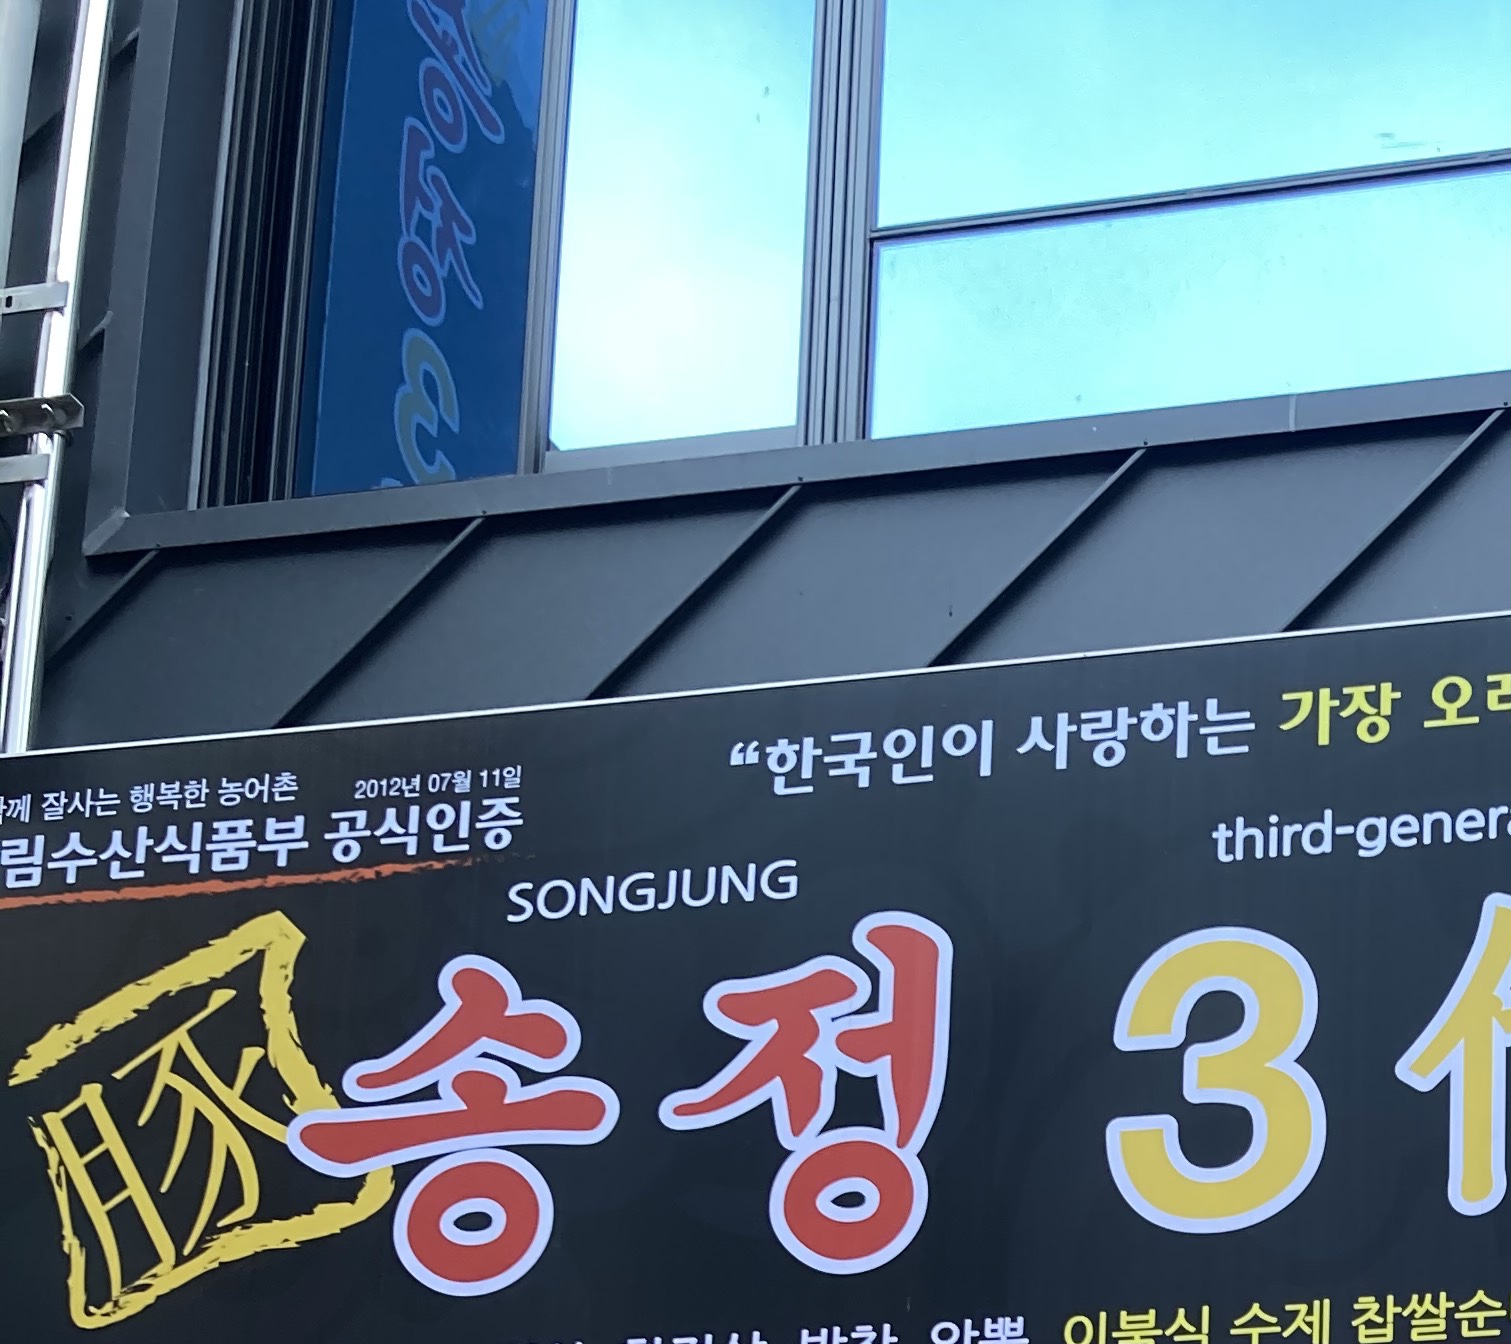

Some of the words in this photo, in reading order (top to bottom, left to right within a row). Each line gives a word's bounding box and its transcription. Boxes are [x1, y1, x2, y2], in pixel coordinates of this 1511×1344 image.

[730, 719, 994, 797] “한국인이
[1016, 697, 1257, 771] 사랑하는
[1280, 680, 1402, 747] 가장
[41, 786, 122, 822] 잘사는
[130, 777, 210, 814] 행복한
[217, 771, 299, 808] 농어촌
[354, 772, 421, 801] 2012년
[428, 768, 472, 796] 07월
[479, 763, 523, 791] 11일
[323, 795, 524, 864] 공식인증
[506, 858, 800, 923] SONGJUNG
